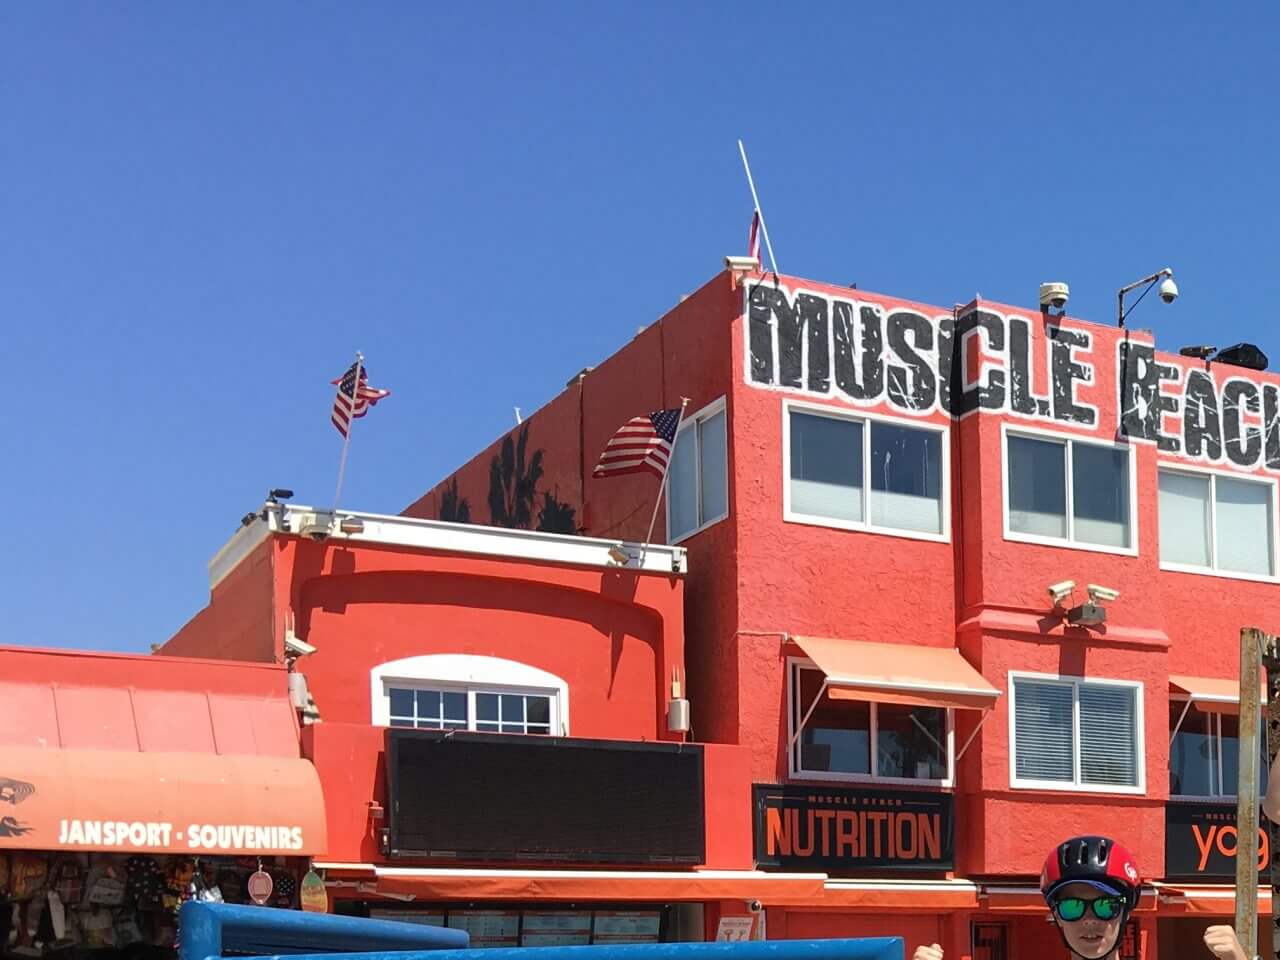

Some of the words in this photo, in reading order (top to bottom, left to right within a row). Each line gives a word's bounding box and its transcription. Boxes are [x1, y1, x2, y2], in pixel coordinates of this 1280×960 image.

[748, 284, 1096, 425] MUSCLE
[808, 796, 857, 805] MUSCLE
[59, 819, 172, 846] JANSPORT
[188, 824, 303, 849] SOUVENIRS
[767, 807, 941, 860] NUTRITION
